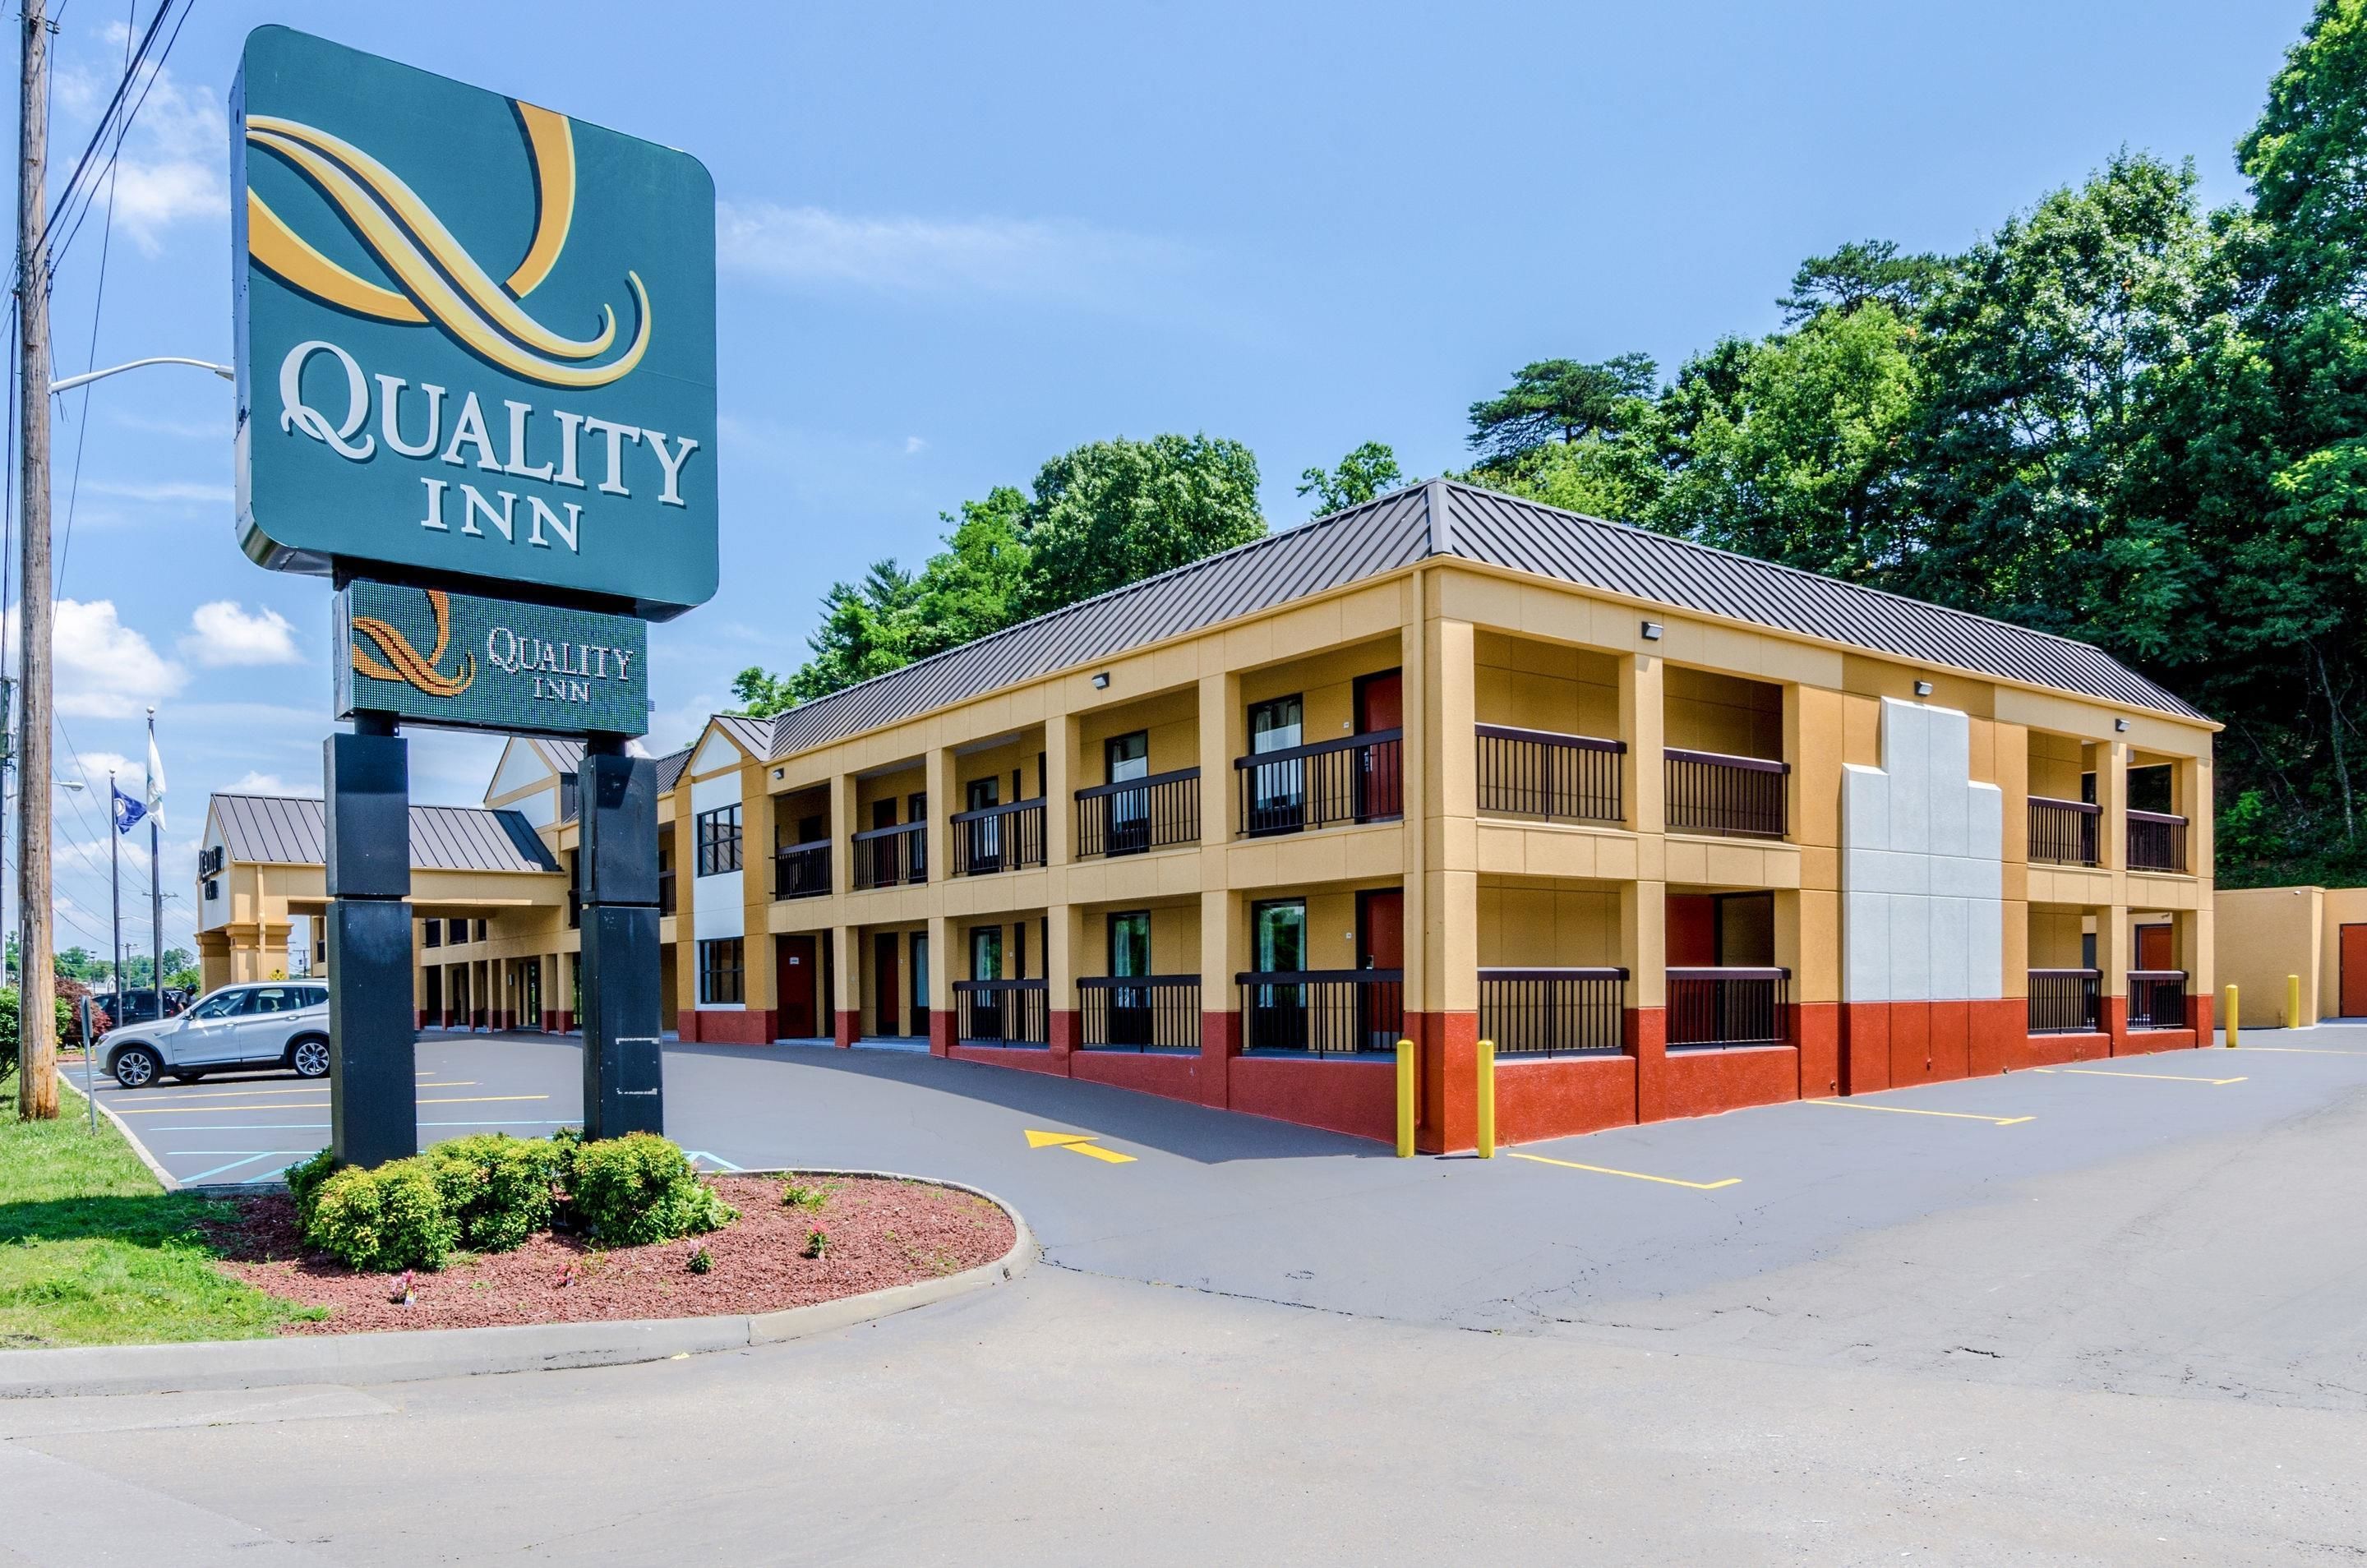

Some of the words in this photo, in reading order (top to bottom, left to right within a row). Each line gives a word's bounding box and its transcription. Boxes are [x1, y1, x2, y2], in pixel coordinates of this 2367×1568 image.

[279, 340, 699, 507] QUALITY
[420, 477, 583, 552] INN
[488, 627, 634, 681] QUALITY
[533, 676, 590, 703] INN
